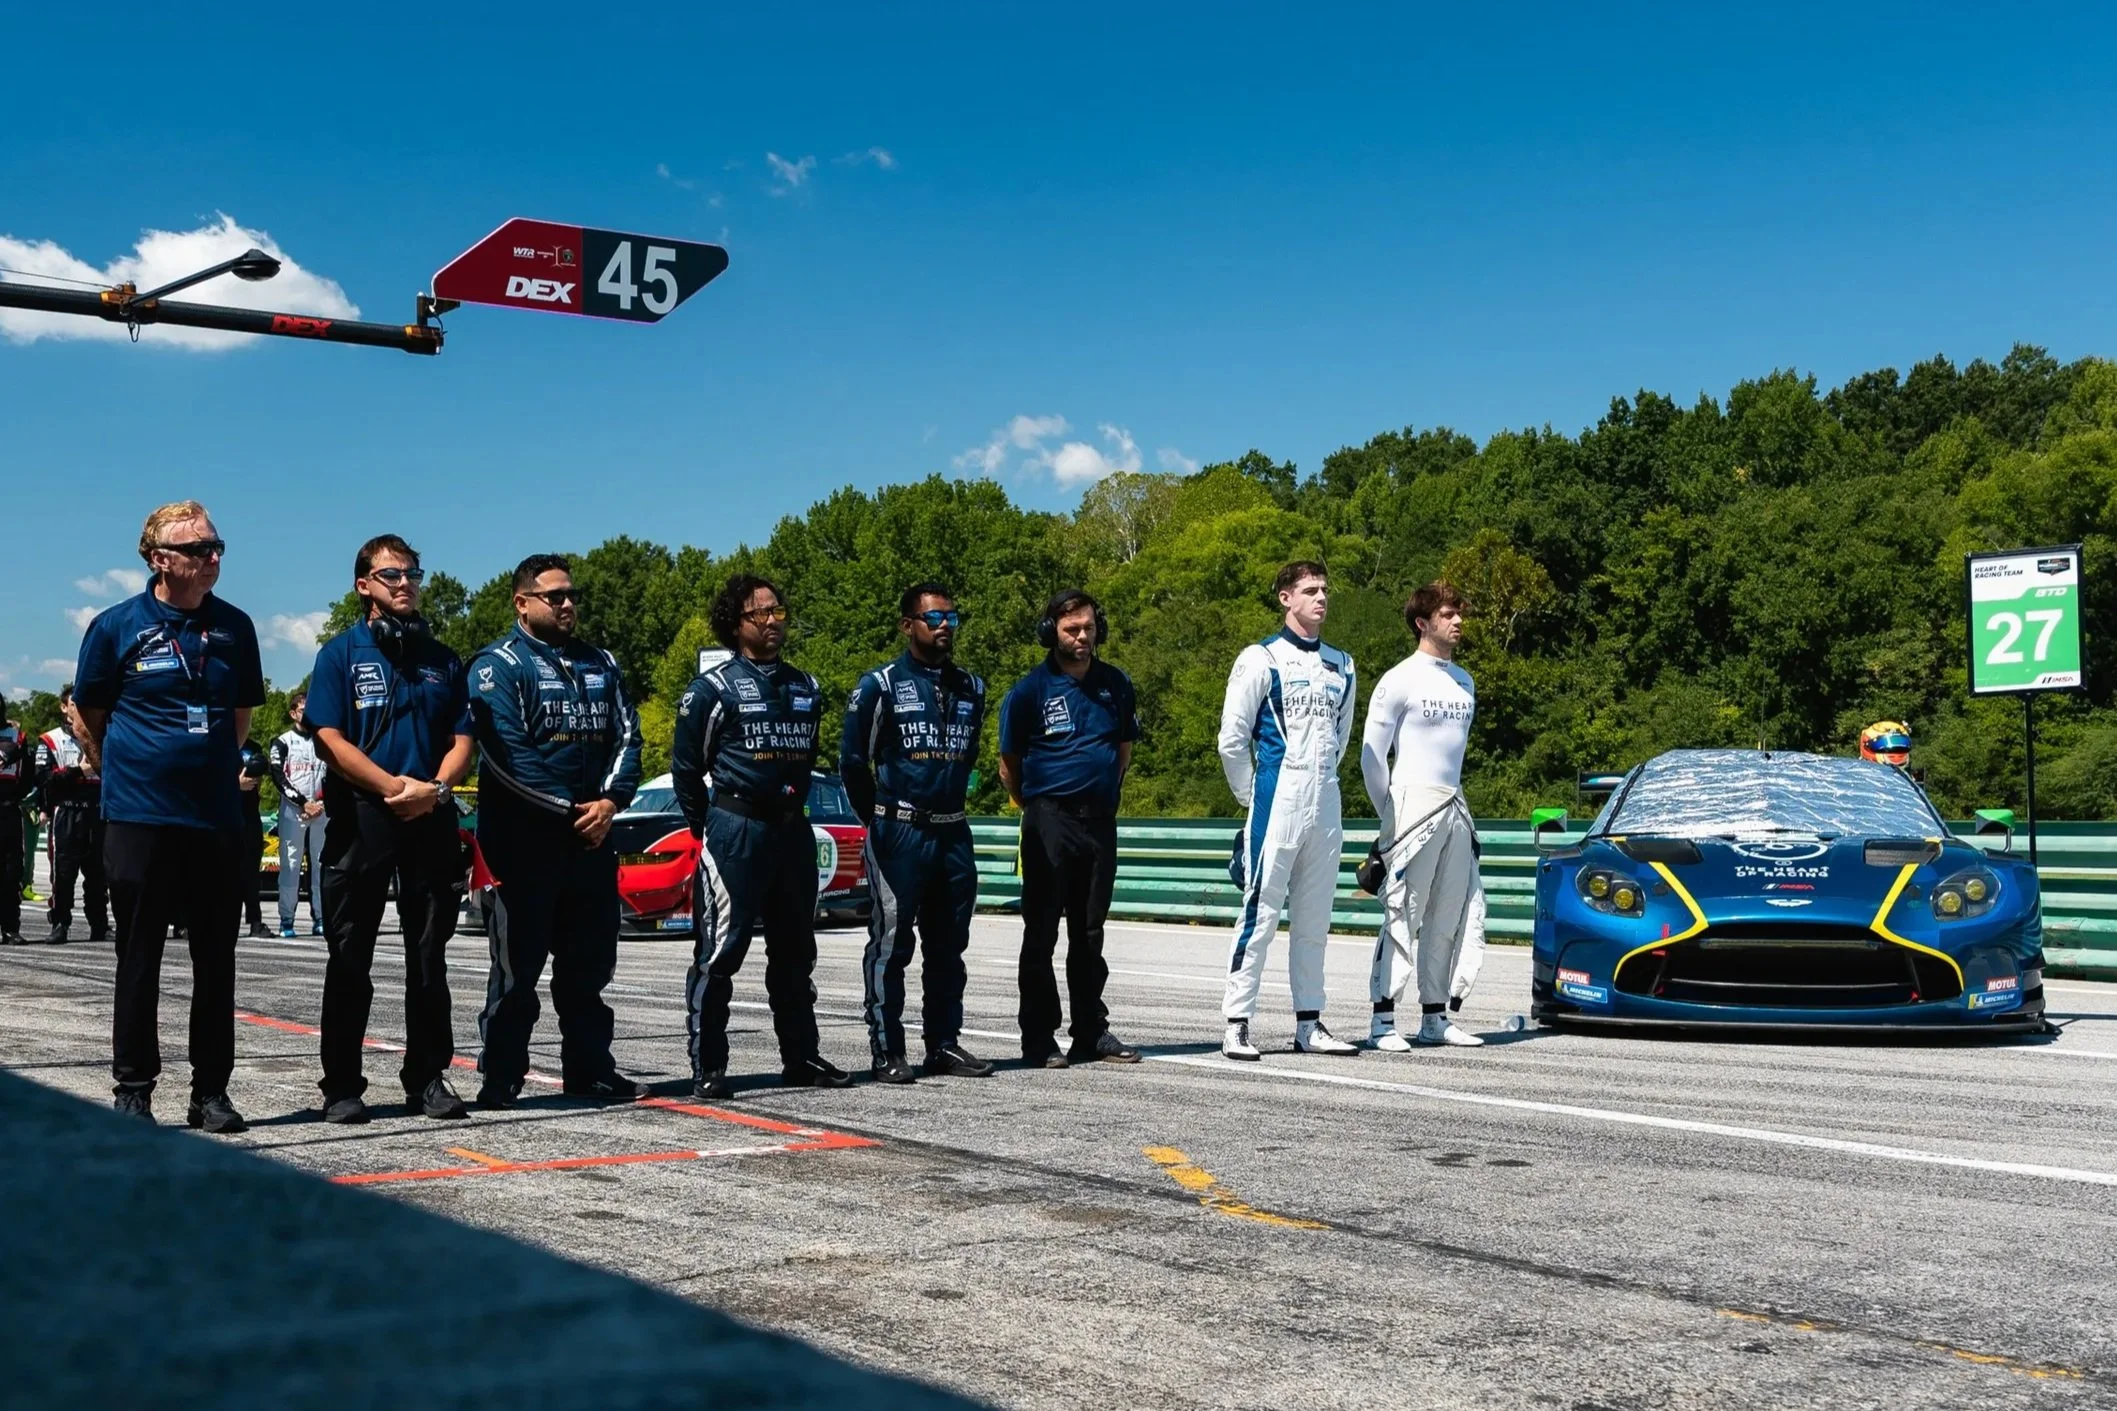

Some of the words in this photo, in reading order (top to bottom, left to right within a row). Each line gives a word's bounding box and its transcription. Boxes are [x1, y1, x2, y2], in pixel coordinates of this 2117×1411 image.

[513, 247, 535, 256] WTR
[598, 241, 678, 314] 45
[505, 276, 576, 304] DEX
[271, 313, 333, 337] DEX
[1975, 571, 2002, 579] RACING
[2035, 587, 2068, 598] GTD
[1986, 609, 2063, 665] 27
[543, 701, 571, 714] THE
[1284, 696, 1306, 706] THE
[1311, 697, 1338, 708] HEAR
[1422, 700, 1443, 708] THE
[1448, 702, 1472, 711] HEAR
[1285, 708, 1300, 717] OF
[1423, 710, 1438, 718] OF
[1443, 711, 1471, 720] RACIN
[545, 716, 562, 728] OF
[742, 722, 771, 736] THE
[775, 722, 812, 735] HEART
[899, 722, 927, 735] THE
[745, 737, 763, 749] OF
[903, 736, 920, 748] OF
[911, 752, 928, 760] JOIN
[1560, 971, 1588, 984] MOTUL
[1988, 978, 2016, 991] MOTUL
[1984, 994, 2014, 1003] MICHELIN
